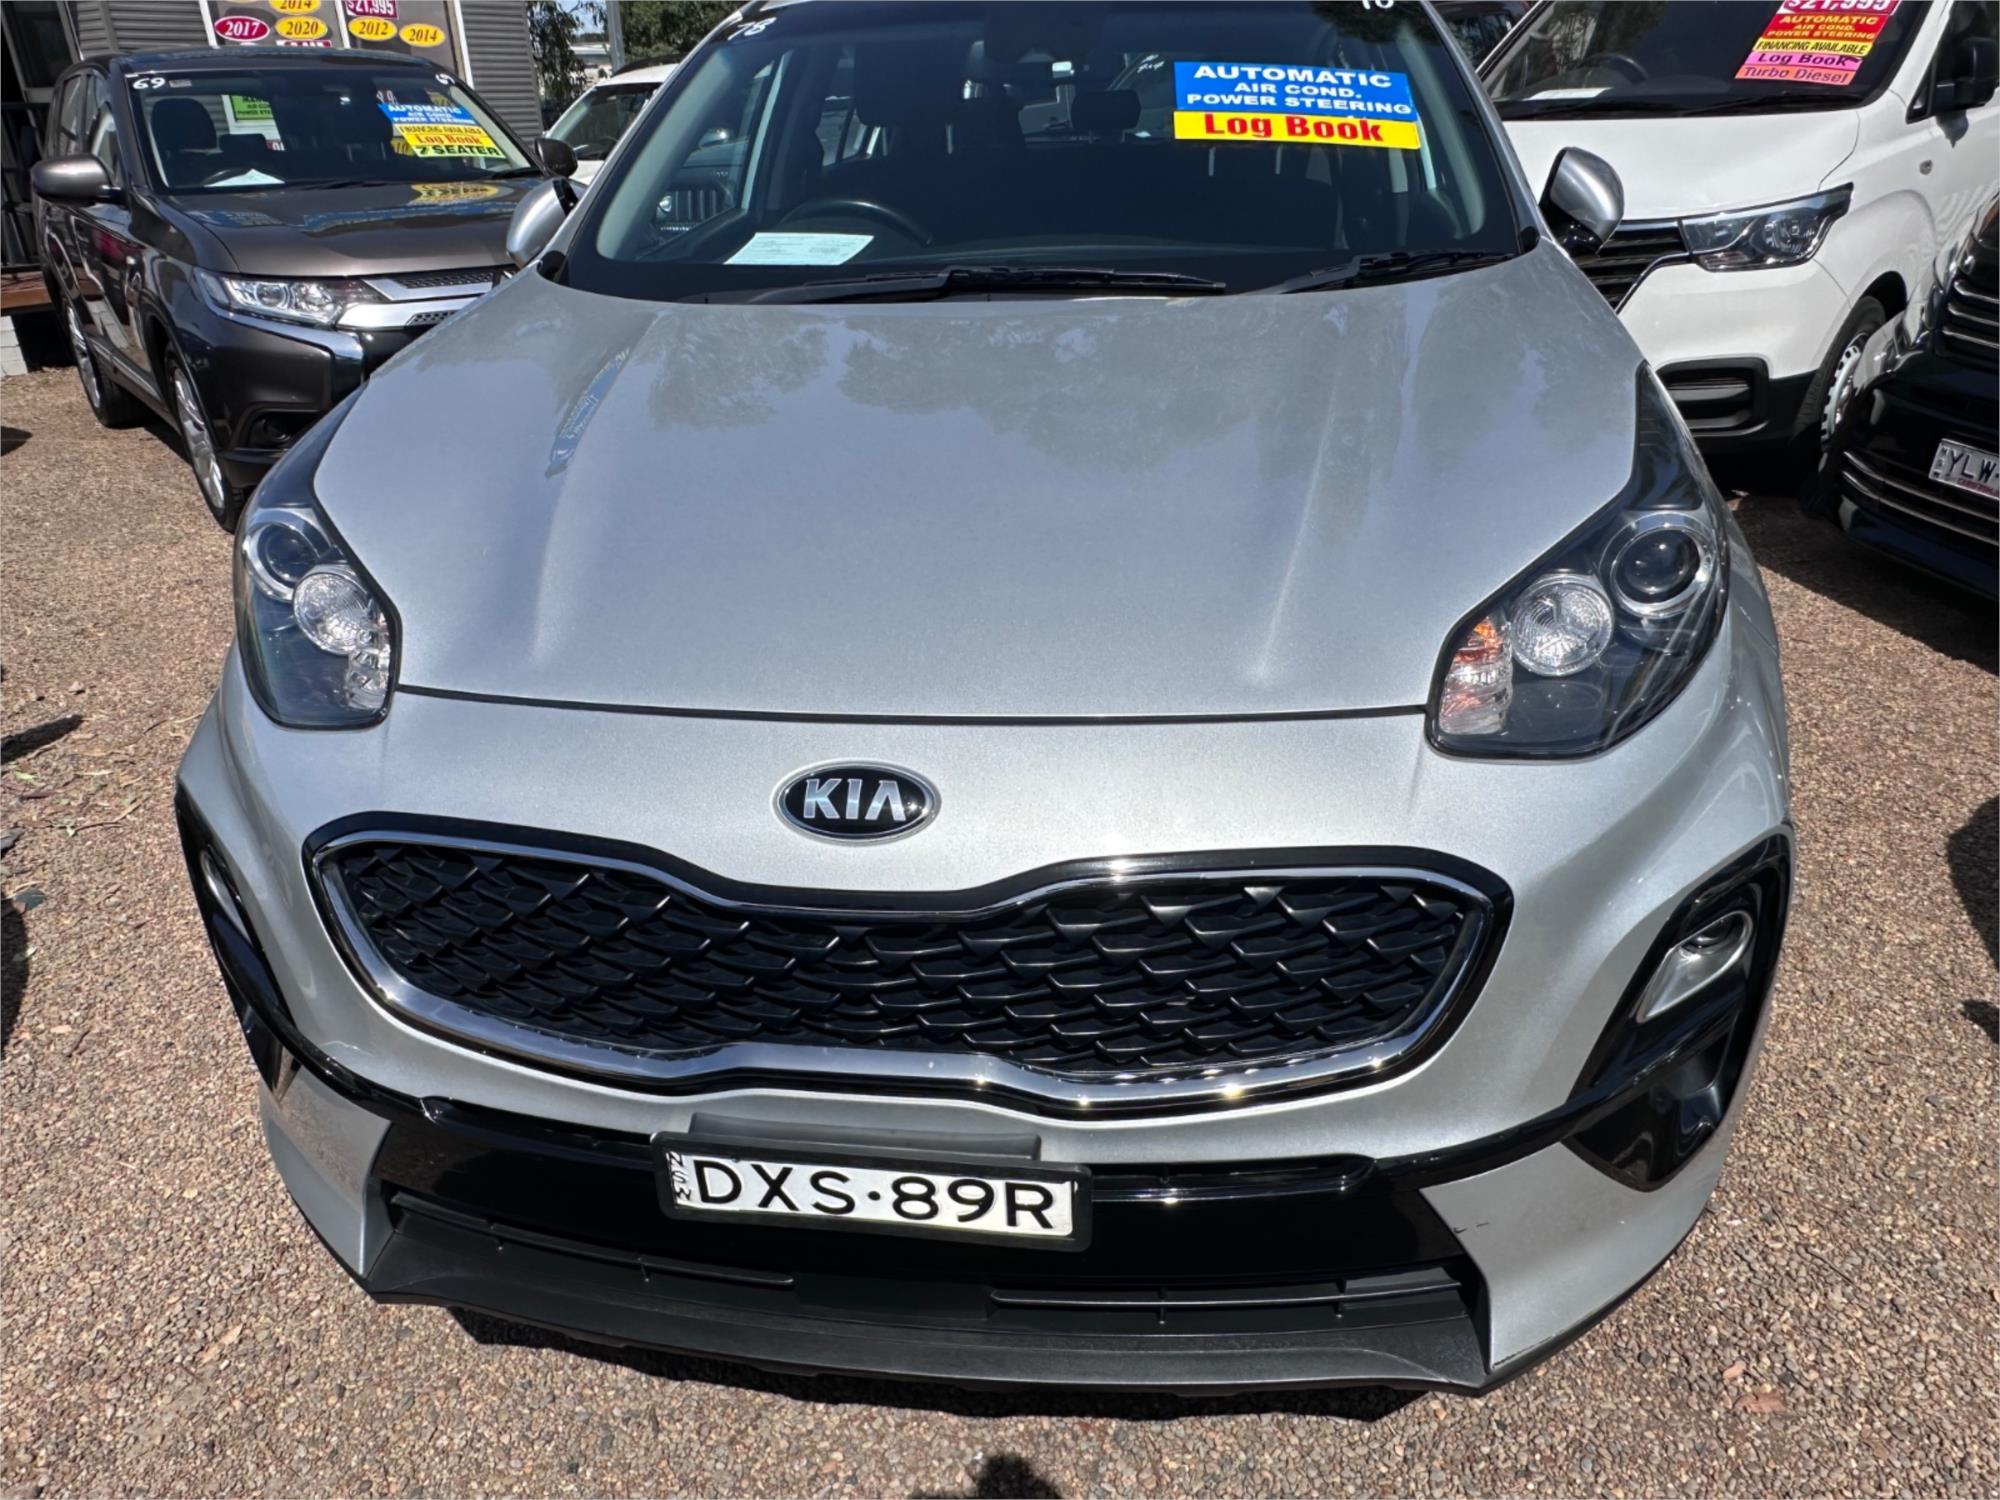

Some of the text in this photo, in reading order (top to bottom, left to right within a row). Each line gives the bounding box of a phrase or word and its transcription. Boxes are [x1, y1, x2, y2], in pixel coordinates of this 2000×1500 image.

[1780, 15, 1879, 25] AUTOMATIC
[224, 21, 259, 36] 2017
[286, 21, 319, 36] 2020
[358, 21, 389, 36] 2012
[409, 27, 438, 42] 2014
[1813, 30, 1876, 39] STEERING
[1755, 41, 1868, 54] FINANCING AVAILABLE
[1758, 53, 1849, 67] Log Book
[1193, 64, 1393, 88] AUTOMATIC
[1744, 66, 1850, 84] Turbo Diesel
[132, 77, 166, 90] 69
[1234, 82, 1362, 99] AIR COND.
[388, 104, 462, 115] AUTOMATIC
[1186, 93, 1413, 114] POWER STEERING
[1203, 112, 1384, 142] Log Book
[415, 133, 483, 145] Log Book
[418, 145, 429, 155] 7
[432, 145, 501, 156] SEATER
[803, 778, 907, 821] KIA
